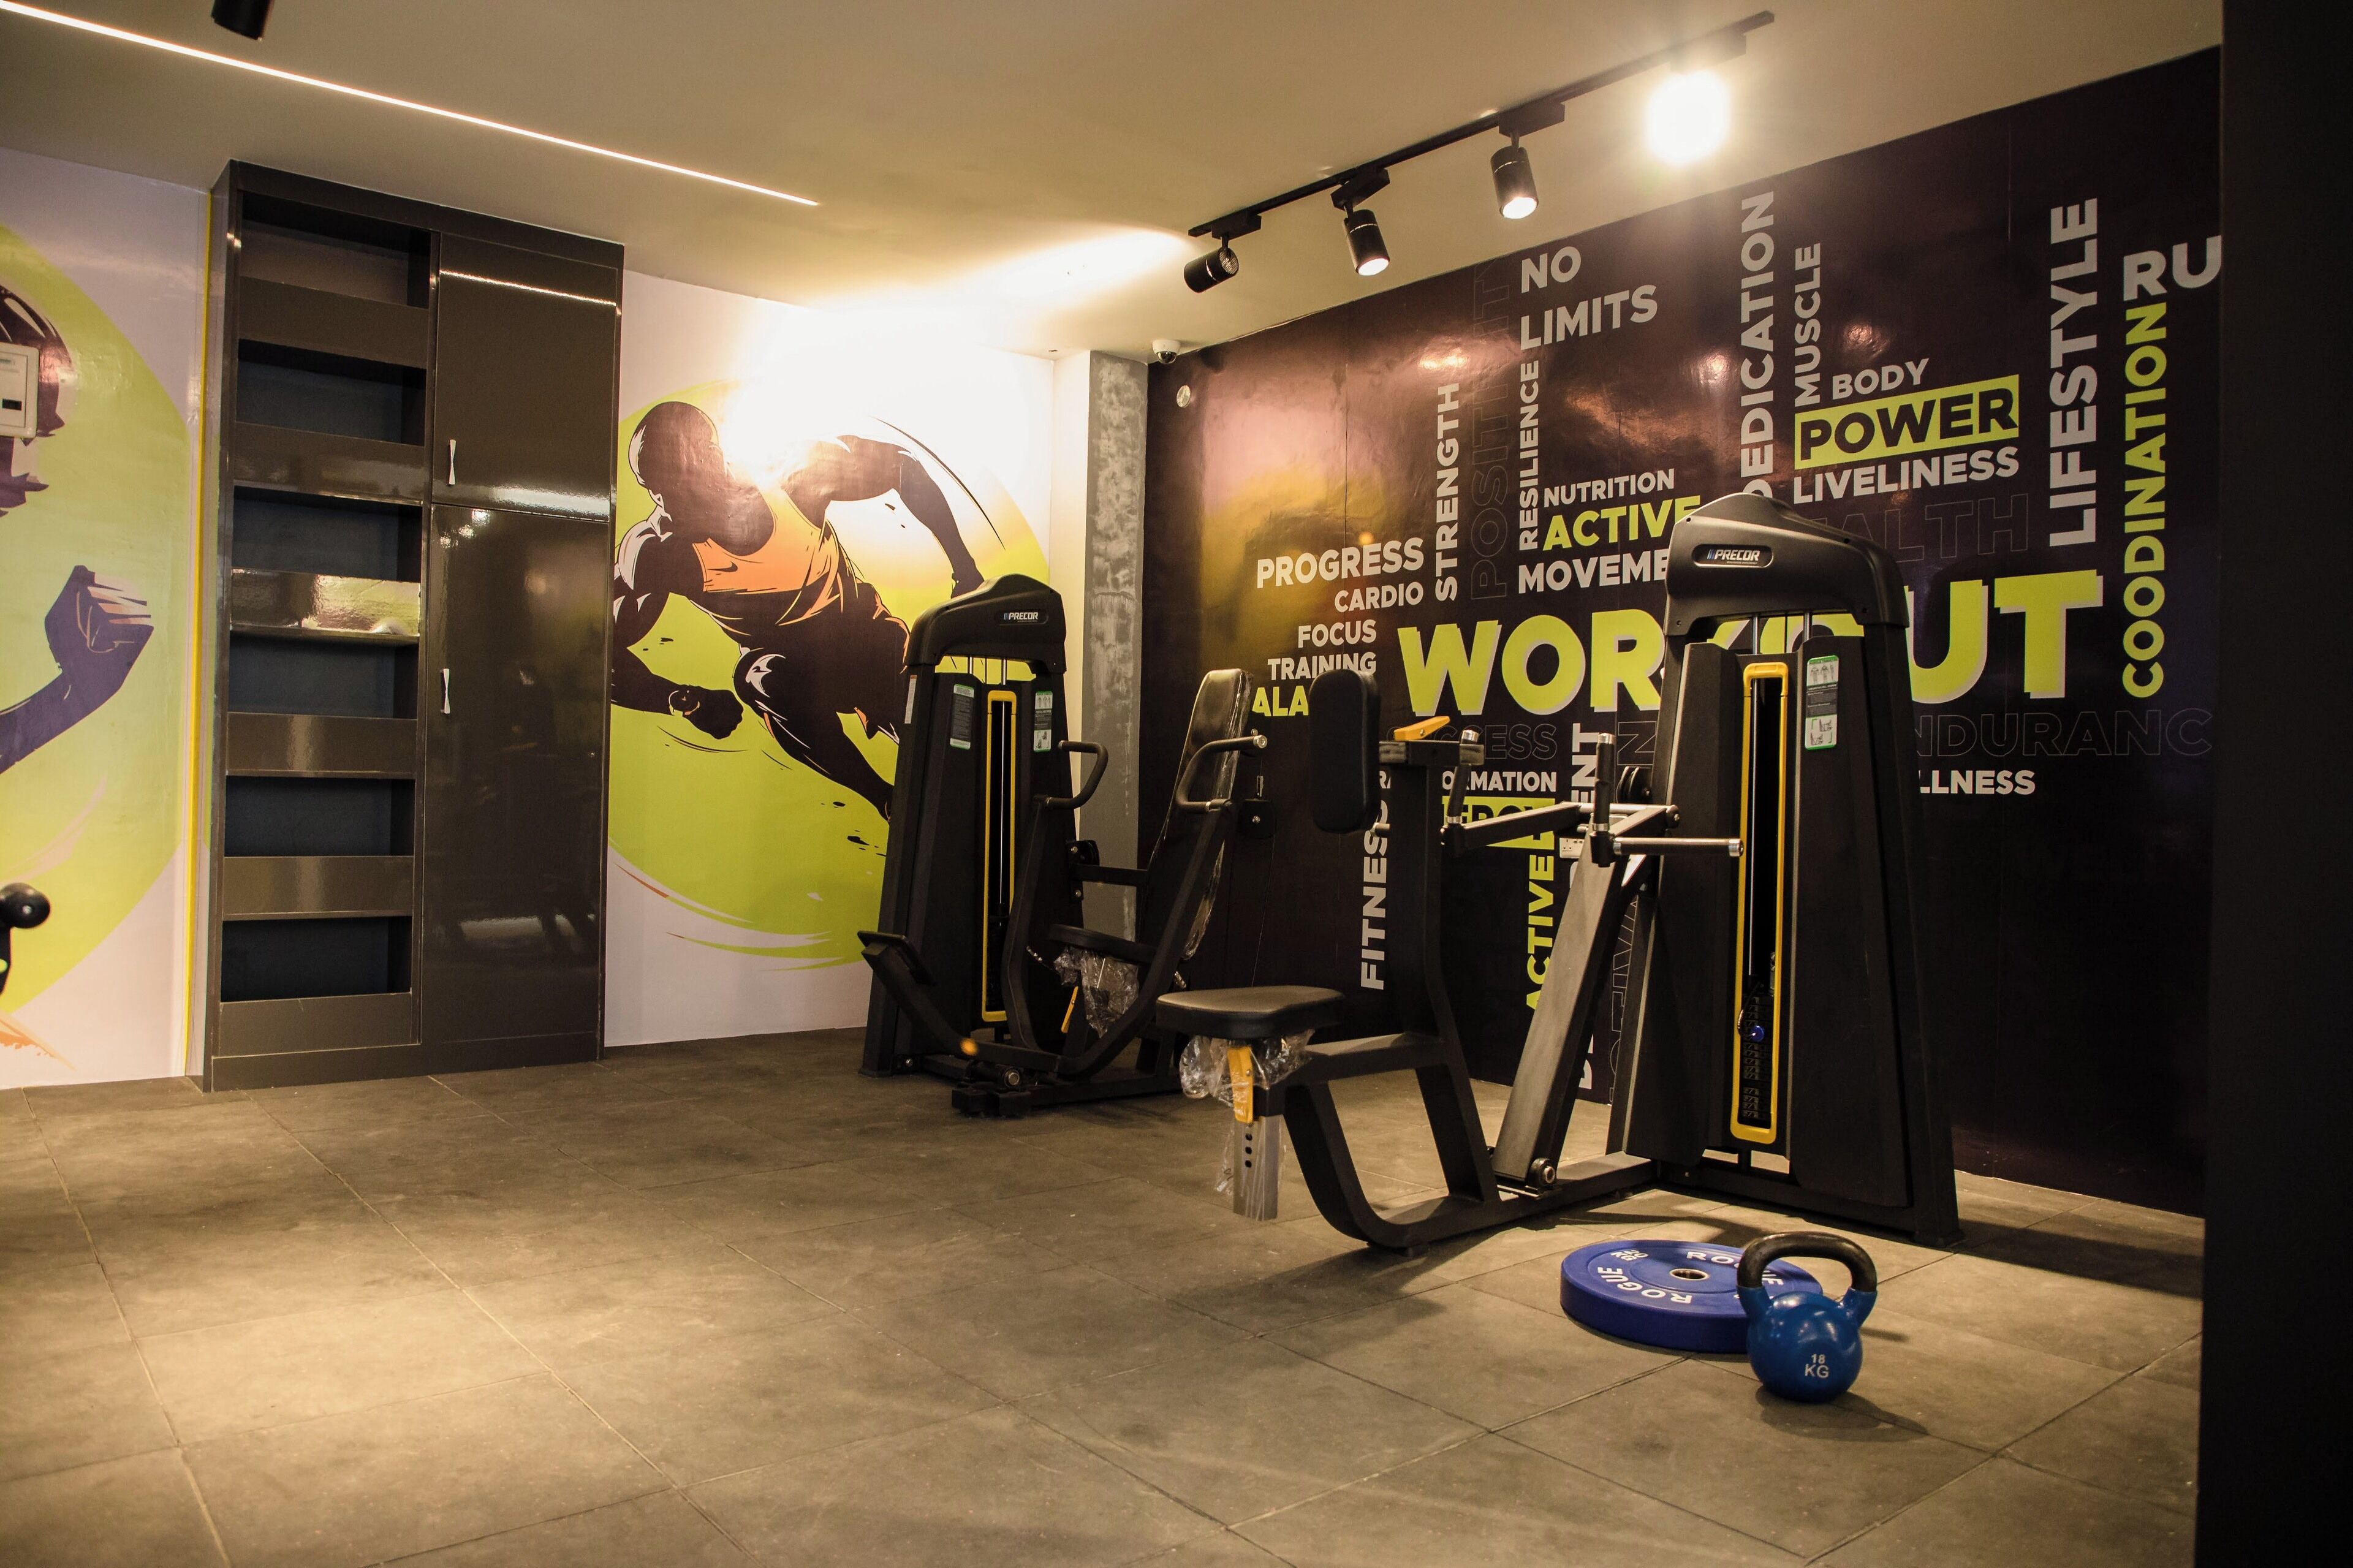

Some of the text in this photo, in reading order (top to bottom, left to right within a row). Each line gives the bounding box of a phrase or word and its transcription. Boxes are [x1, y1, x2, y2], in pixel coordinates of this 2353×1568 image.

[1521, 246, 1582, 294] NO
[2123, 235, 2222, 301] RU
[1520, 285, 1658, 350] LIMITS
[1795, 243, 1821, 407] MUSCLE
[1832, 358, 1930, 401] BODY
[2050, 198, 2098, 547] LIFESTYLE
[1800, 388, 2018, 461] POWER
[1519, 360, 1540, 551] RESILIENCE
[1794, 446, 2019, 504] LIVELINESS
[1435, 383, 1459, 602] STRENGTH
[1544, 468, 1675, 507] NUTRITION
[2122, 303, 2167, 698] COODINATION
[1257, 537, 1424, 588] PROGRESS
[1518, 548, 1669, 594] MOVEME
[1713, 549, 1760, 561] PRECOR
[1009, 612, 1039, 620] PRECOR
[1335, 581, 1424, 613] CARDIO
[1298, 619, 1377, 648] FOCUS
[1398, 570, 2104, 717] WORUT
[1267, 651, 1376, 680] TRAINING
[1597, 1267, 1692, 1304] ROGUE
[1805, 1363, 1829, 1379] KG
[1811, 1354, 1825, 1364] 18
